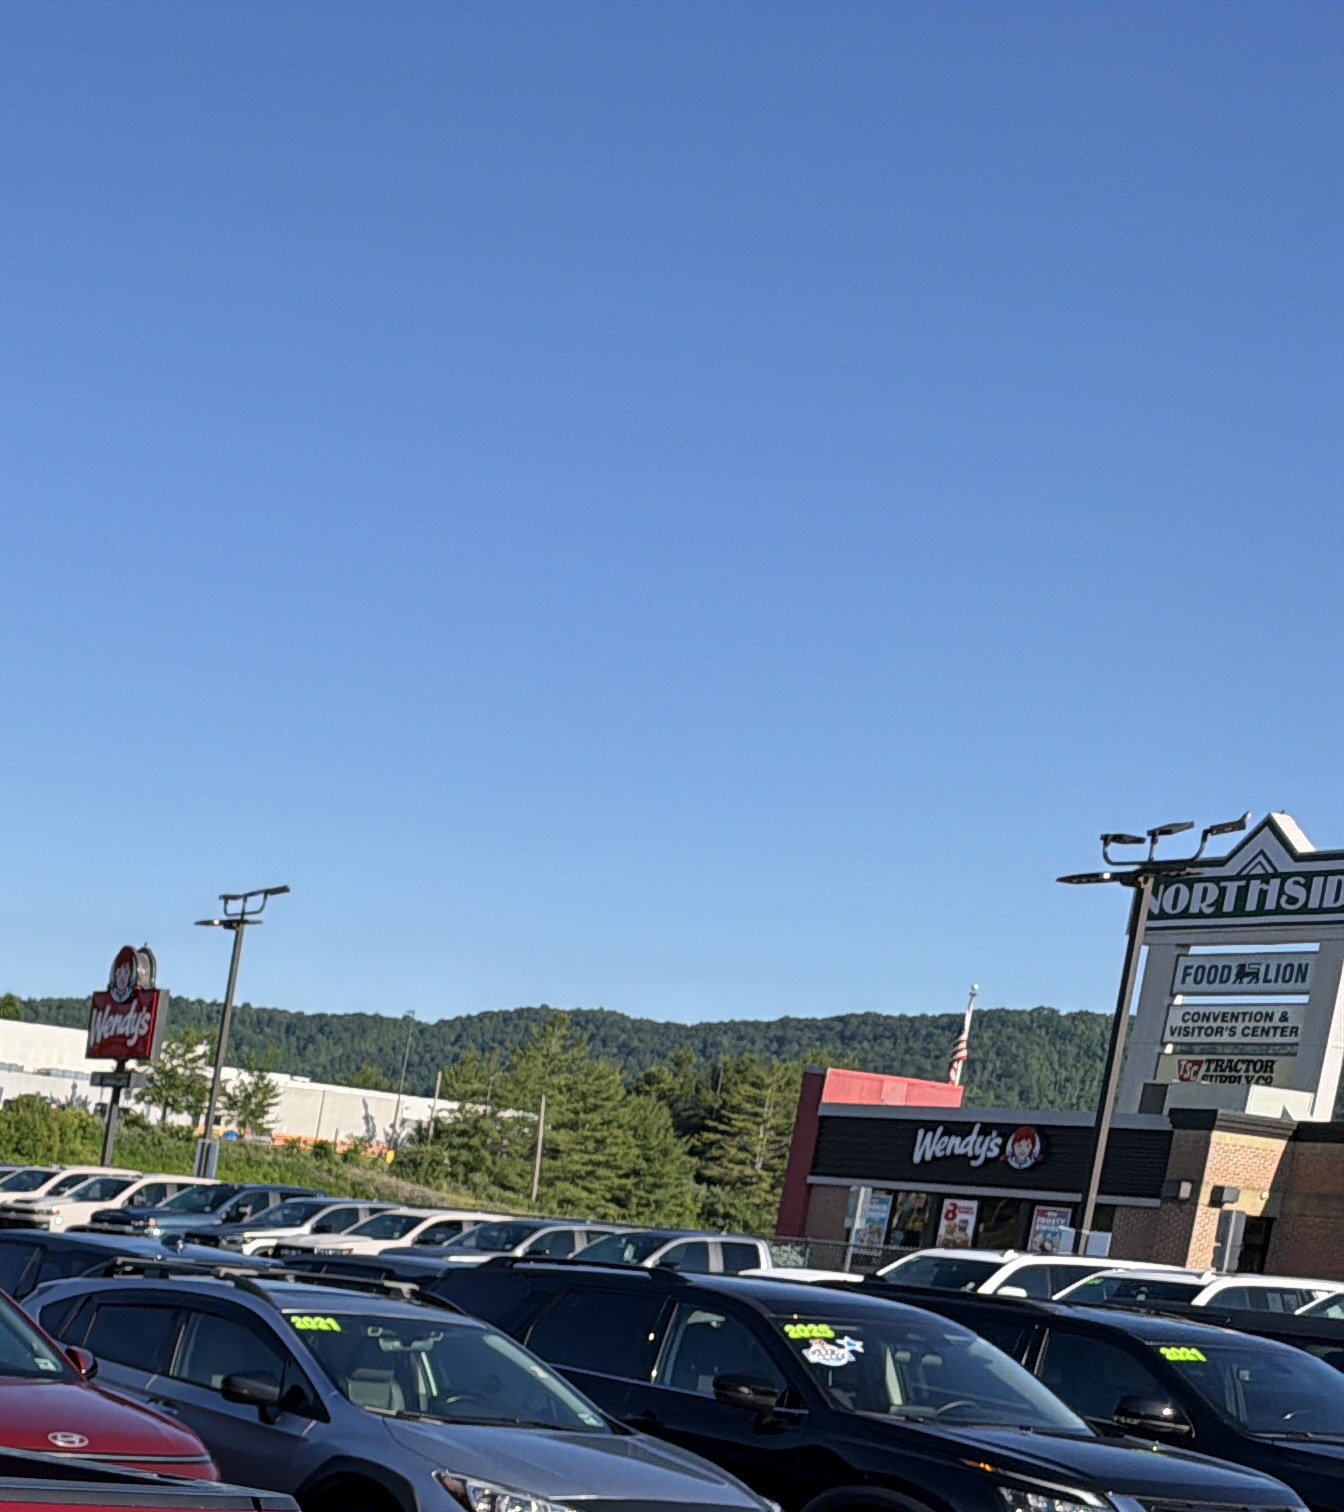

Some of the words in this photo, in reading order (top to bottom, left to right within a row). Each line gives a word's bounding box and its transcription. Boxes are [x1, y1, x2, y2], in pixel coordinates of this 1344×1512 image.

[1180, 964, 1232, 985] FOOD
[1262, 962, 1310, 984] LION
[90, 998, 151, 1048] Wendy's
[1181, 1011, 1274, 1023] CONVENTION
[1278, 1011, 1289, 1023] &
[1169, 1026, 1237, 1038] VISITOR'S
[1241, 1026, 1300, 1038] CENTER
[1204, 1059, 1276, 1074] TRACTOR
[912, 1122, 1003, 1167] Wendy's
